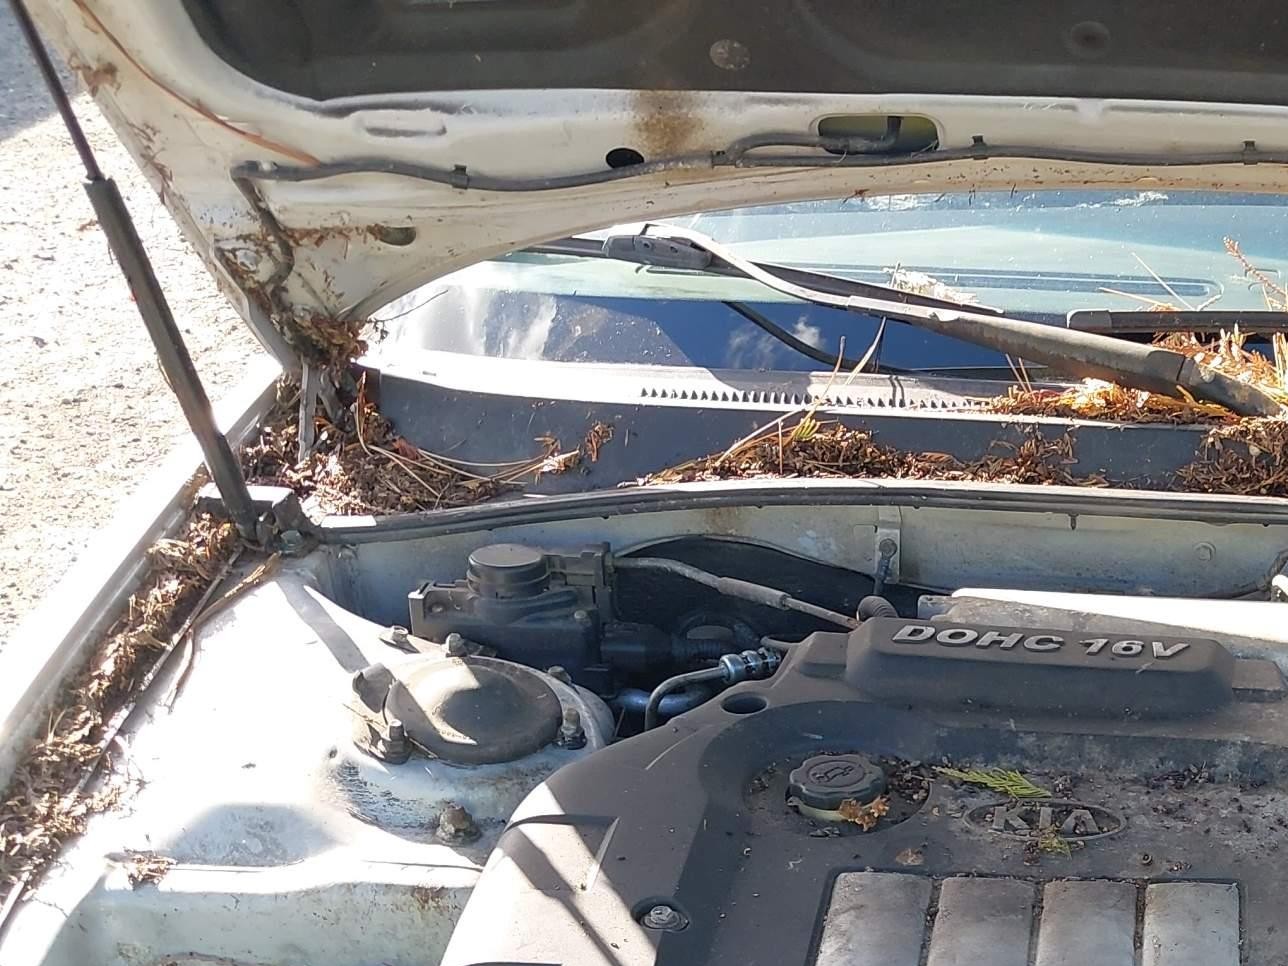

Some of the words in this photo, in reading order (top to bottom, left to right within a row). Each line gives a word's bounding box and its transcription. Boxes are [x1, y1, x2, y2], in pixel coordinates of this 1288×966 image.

[892, 624, 1065, 652] DOHC
[1079, 638, 1191, 659] 16V
[991, 805, 1100, 834] KIA
